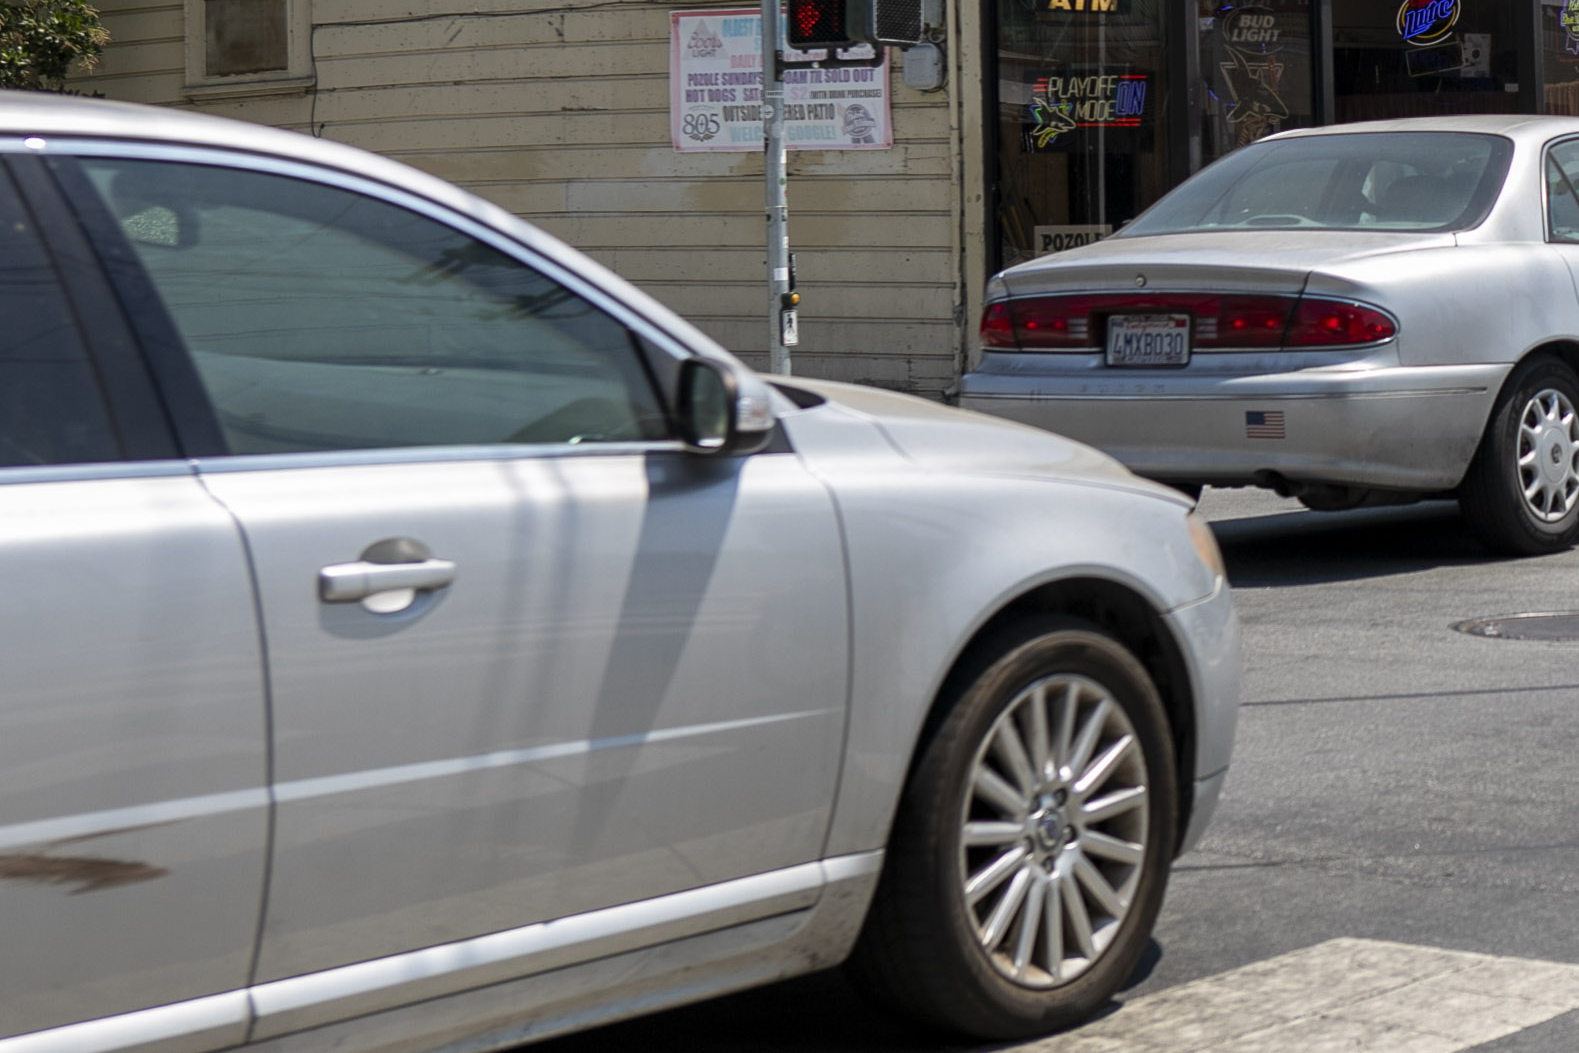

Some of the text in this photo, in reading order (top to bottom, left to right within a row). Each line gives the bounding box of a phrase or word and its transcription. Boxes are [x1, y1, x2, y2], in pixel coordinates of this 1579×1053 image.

[1239, 15, 1275, 27] BUD
[1231, 29, 1281, 42] LIGHT
[692, 49, 717, 58] LIGHT
[688, 73, 719, 87] POZOLE
[824, 69, 850, 83] SOLD
[853, 68, 875, 82] OUT
[685, 89, 705, 103] HOT
[708, 88, 736, 102] DOGS
[1048, 76, 1118, 98] PLAYOFF
[1116, 81, 1146, 116] ON
[807, 103, 835, 120] PATIO
[682, 113, 720, 135] 805
[730, 126, 763, 142] WELC
[1114, 332, 1184, 356] 4MXB030
